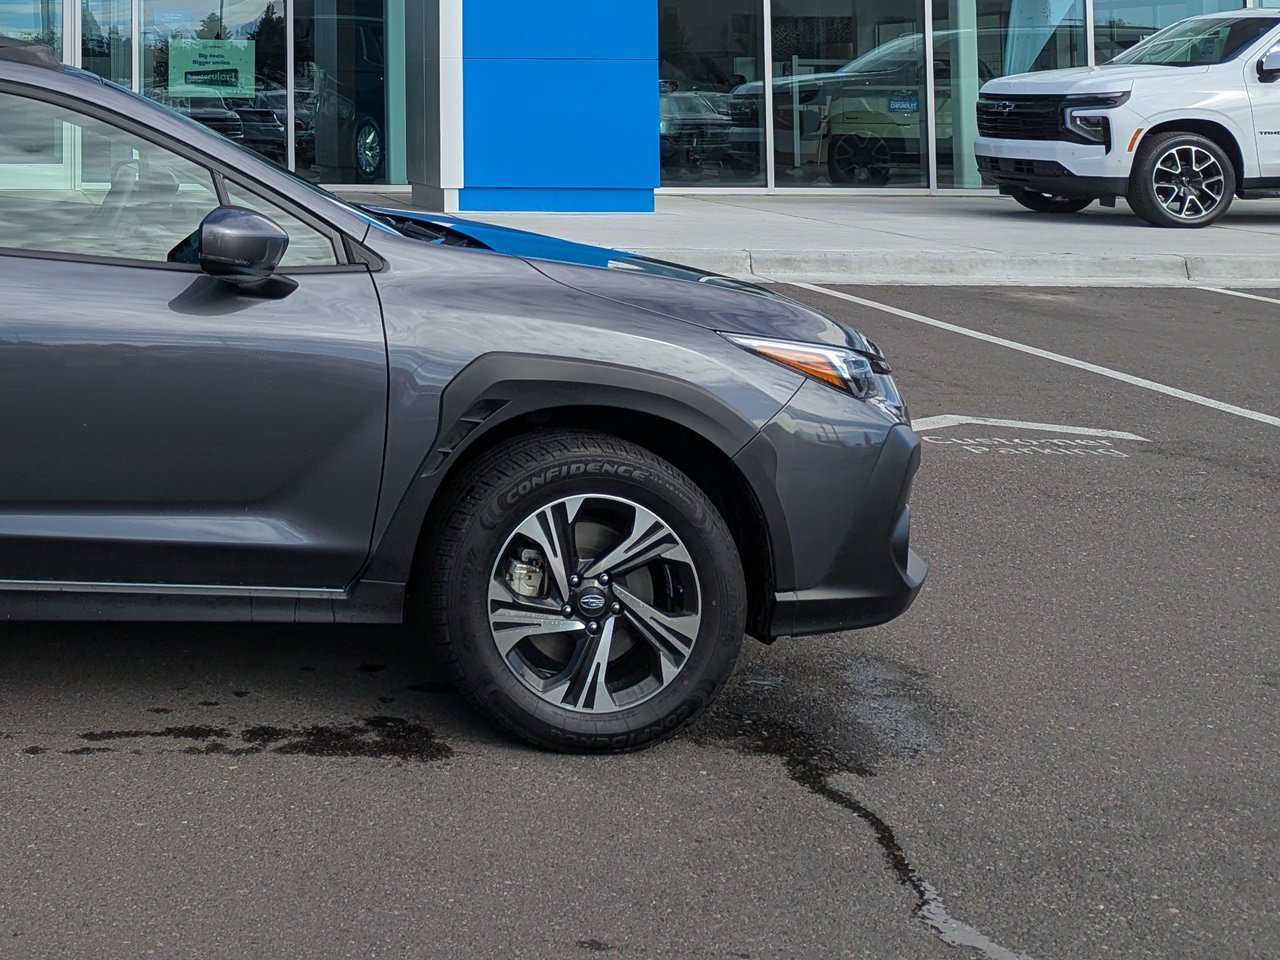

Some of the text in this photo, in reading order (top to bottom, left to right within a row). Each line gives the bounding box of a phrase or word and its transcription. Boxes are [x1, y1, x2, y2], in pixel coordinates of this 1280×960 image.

[921, 436, 1114, 446] Customer
[961, 445, 1130, 458] Parking
[506, 462, 651, 504] CONFIDENCE
